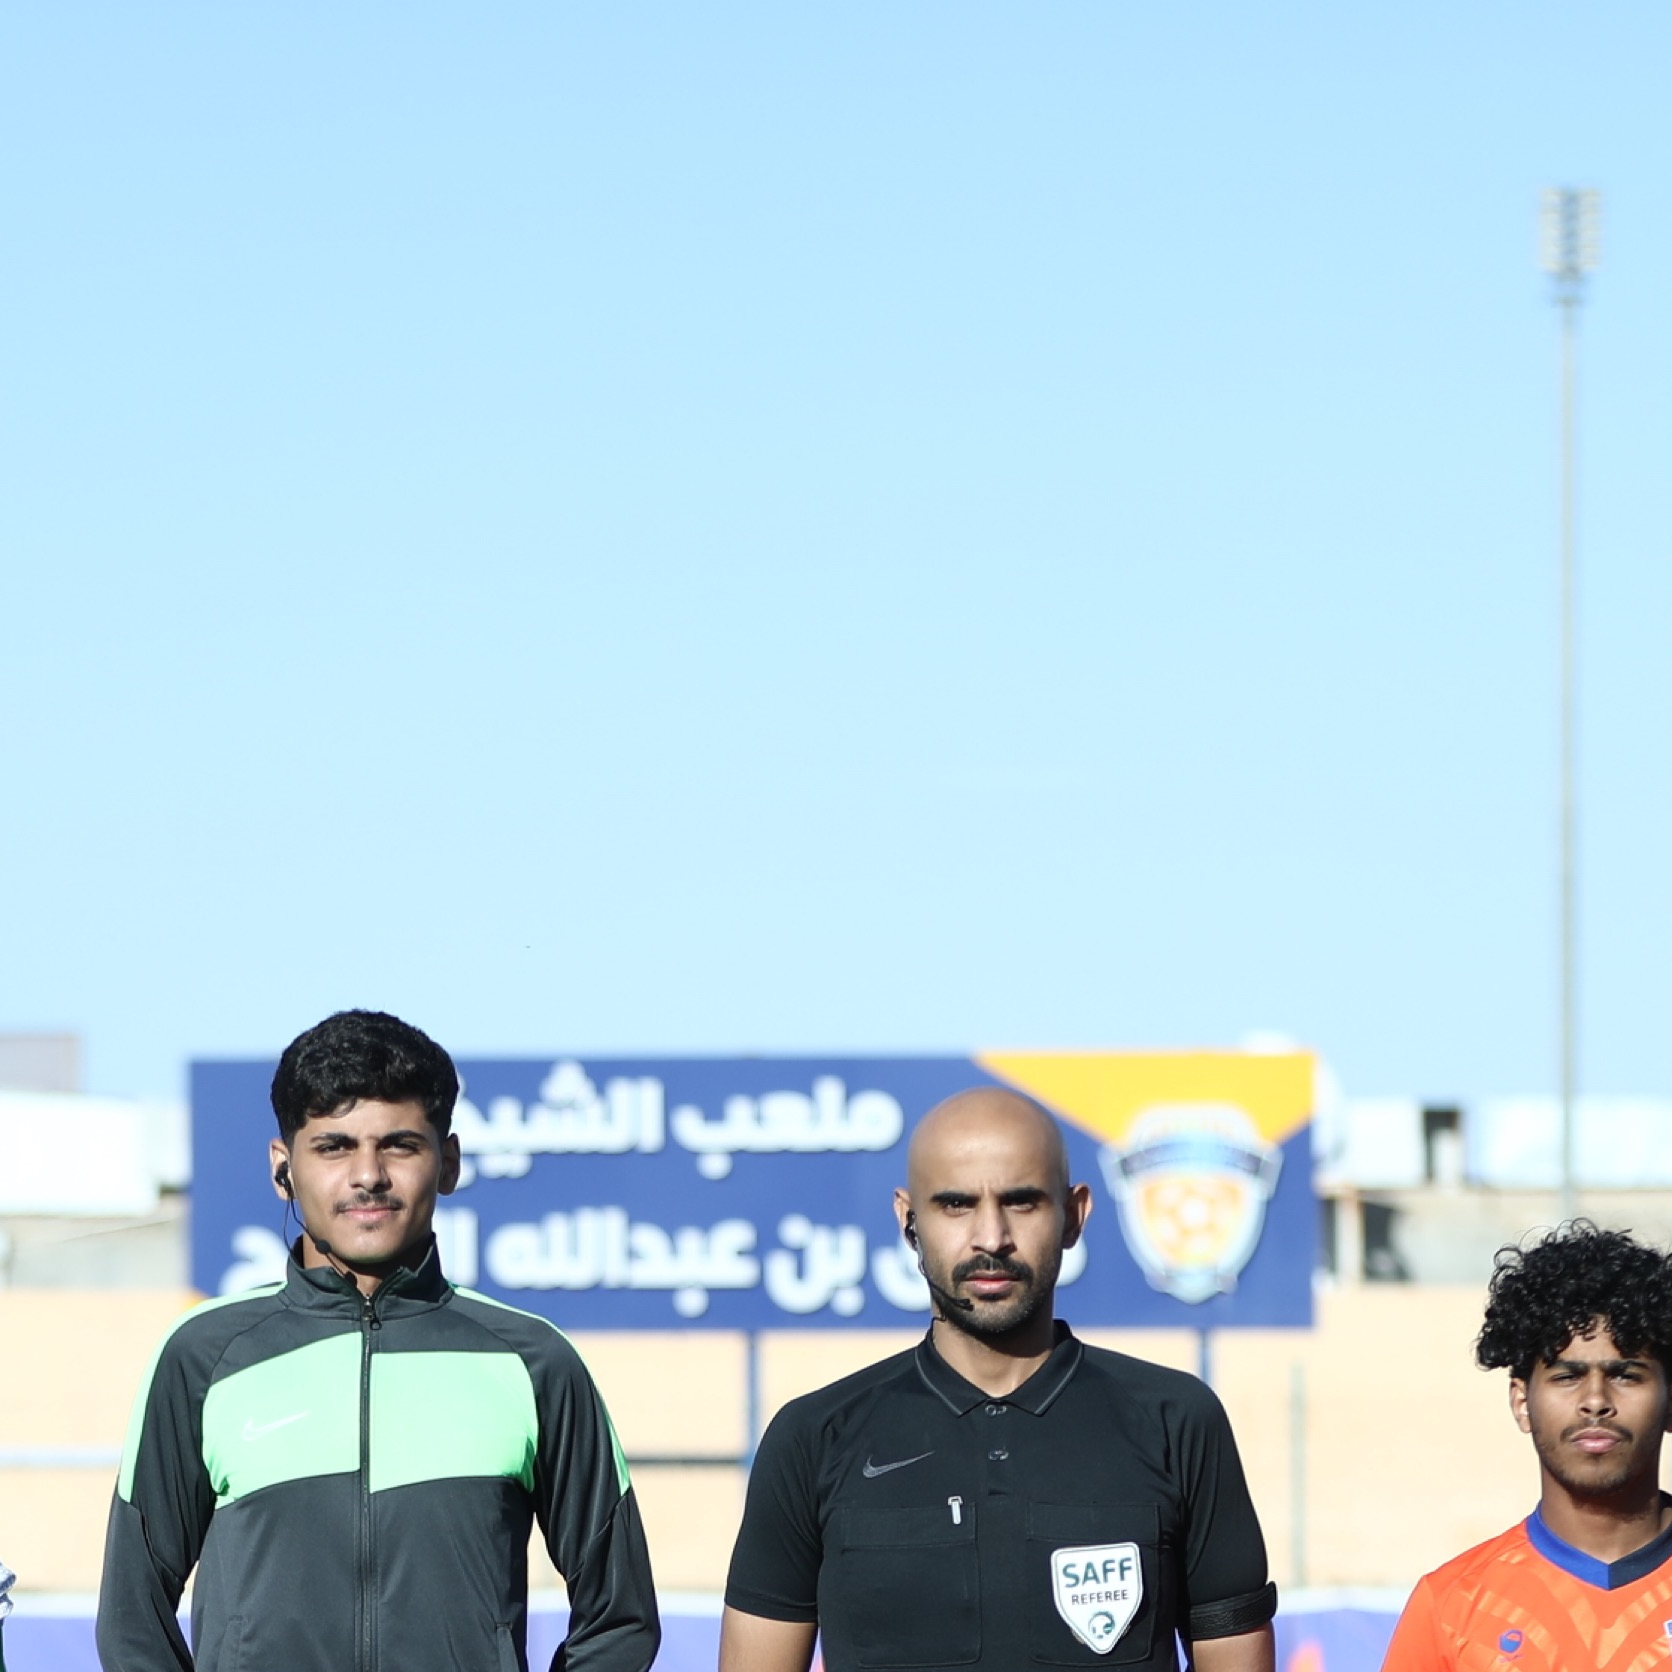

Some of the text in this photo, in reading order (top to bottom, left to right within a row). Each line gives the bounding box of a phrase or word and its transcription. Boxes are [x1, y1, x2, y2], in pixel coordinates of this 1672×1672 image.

[669, 1074, 905, 1181] ملعب
[484, 1204, 762, 1318] عبدالله
[1062, 1556, 1133, 1589] SAFF
[1071, 1589, 1129, 1606] REFEREE
